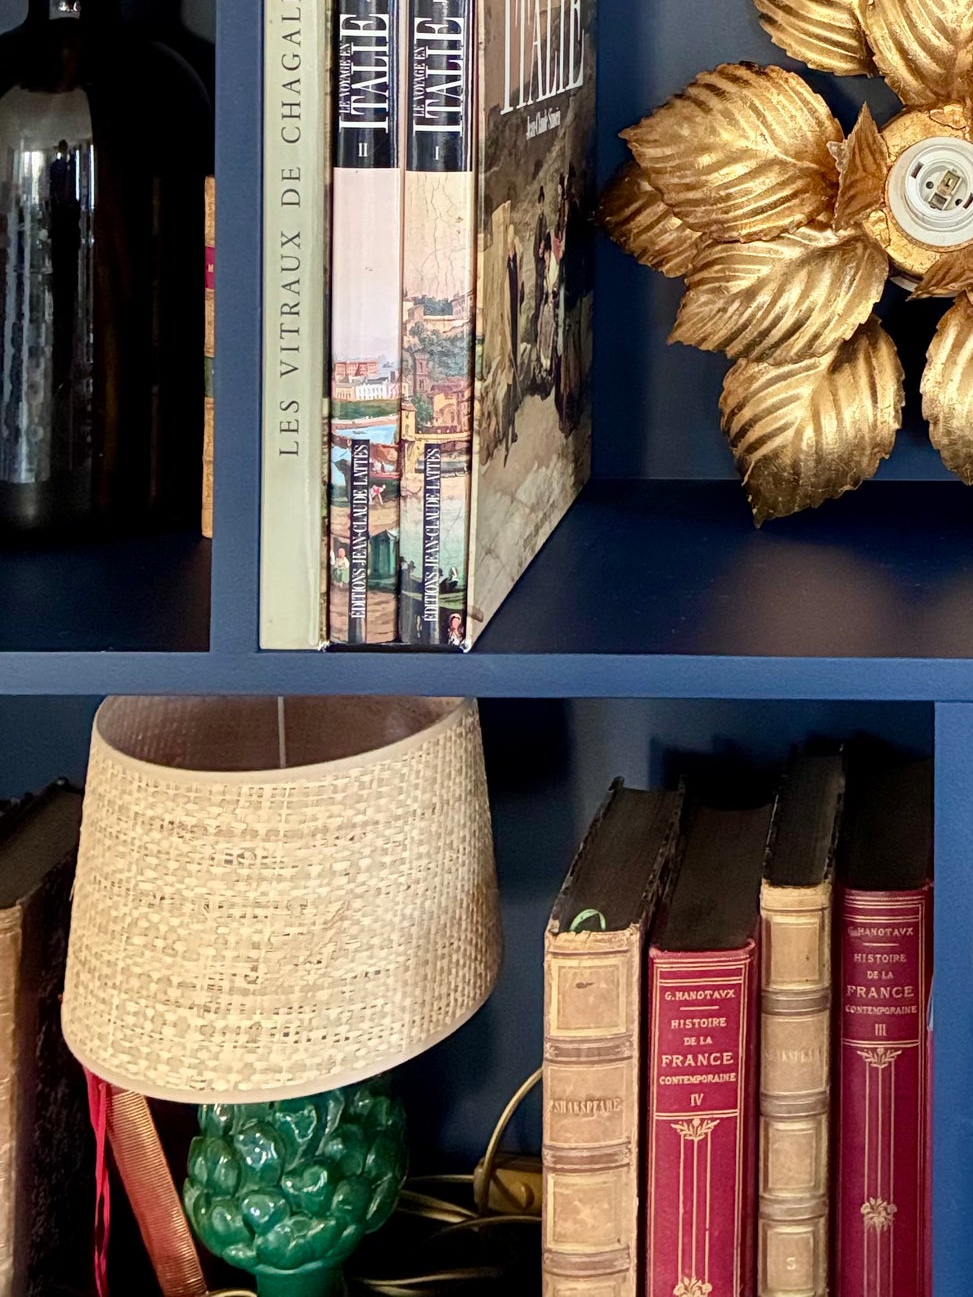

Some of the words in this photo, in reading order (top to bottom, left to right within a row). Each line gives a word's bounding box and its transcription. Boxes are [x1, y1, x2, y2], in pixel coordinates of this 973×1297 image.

[340, 42, 351, 56] EN
[413, 46, 425, 60] EN
[339, 14, 389, 134] ITALIE
[339, 60, 352, 97] VOYAGE
[413, 17, 464, 137] ITALIE
[413, 63, 426, 100] VOYAGE
[340, 99, 351, 113] LE
[413, 104, 425, 118] LE
[358, 143, 368, 157] II
[281, 167, 301, 209] DE
[280, 230, 300, 378] VITRAUX
[279, 400, 299, 457] LES
[351, 444, 369, 486] LATTÈS
[425, 448, 441, 489] LATTÈS
[351, 489, 367, 566] JEAN-CLAUDE
[425, 493, 440, 570] JEAN-CLAUDE
[349, 569, 367, 618] ÉDITIONS
[423, 572, 439, 622] ÉDITIONS
[854, 953, 907, 964] HISTOIRE
[867, 970, 880, 979] DE
[881, 970, 894, 979] LA
[847, 985, 914, 999] FRANCE
[845, 1004, 917, 1015] CONTEMPORAINE
[671, 1018, 727, 1029] HISTOIRE
[875, 1024, 887, 1037] III
[684, 1036, 696, 1046] DE
[699, 1036, 713, 1046] LA
[661, 1052, 734, 1068] FRANCE
[659, 1072, 736, 1085] CONTEMPORAINE
[554, 1098, 621, 1114] SHAKSPEARE
[690, 1093, 704, 1107] IV
